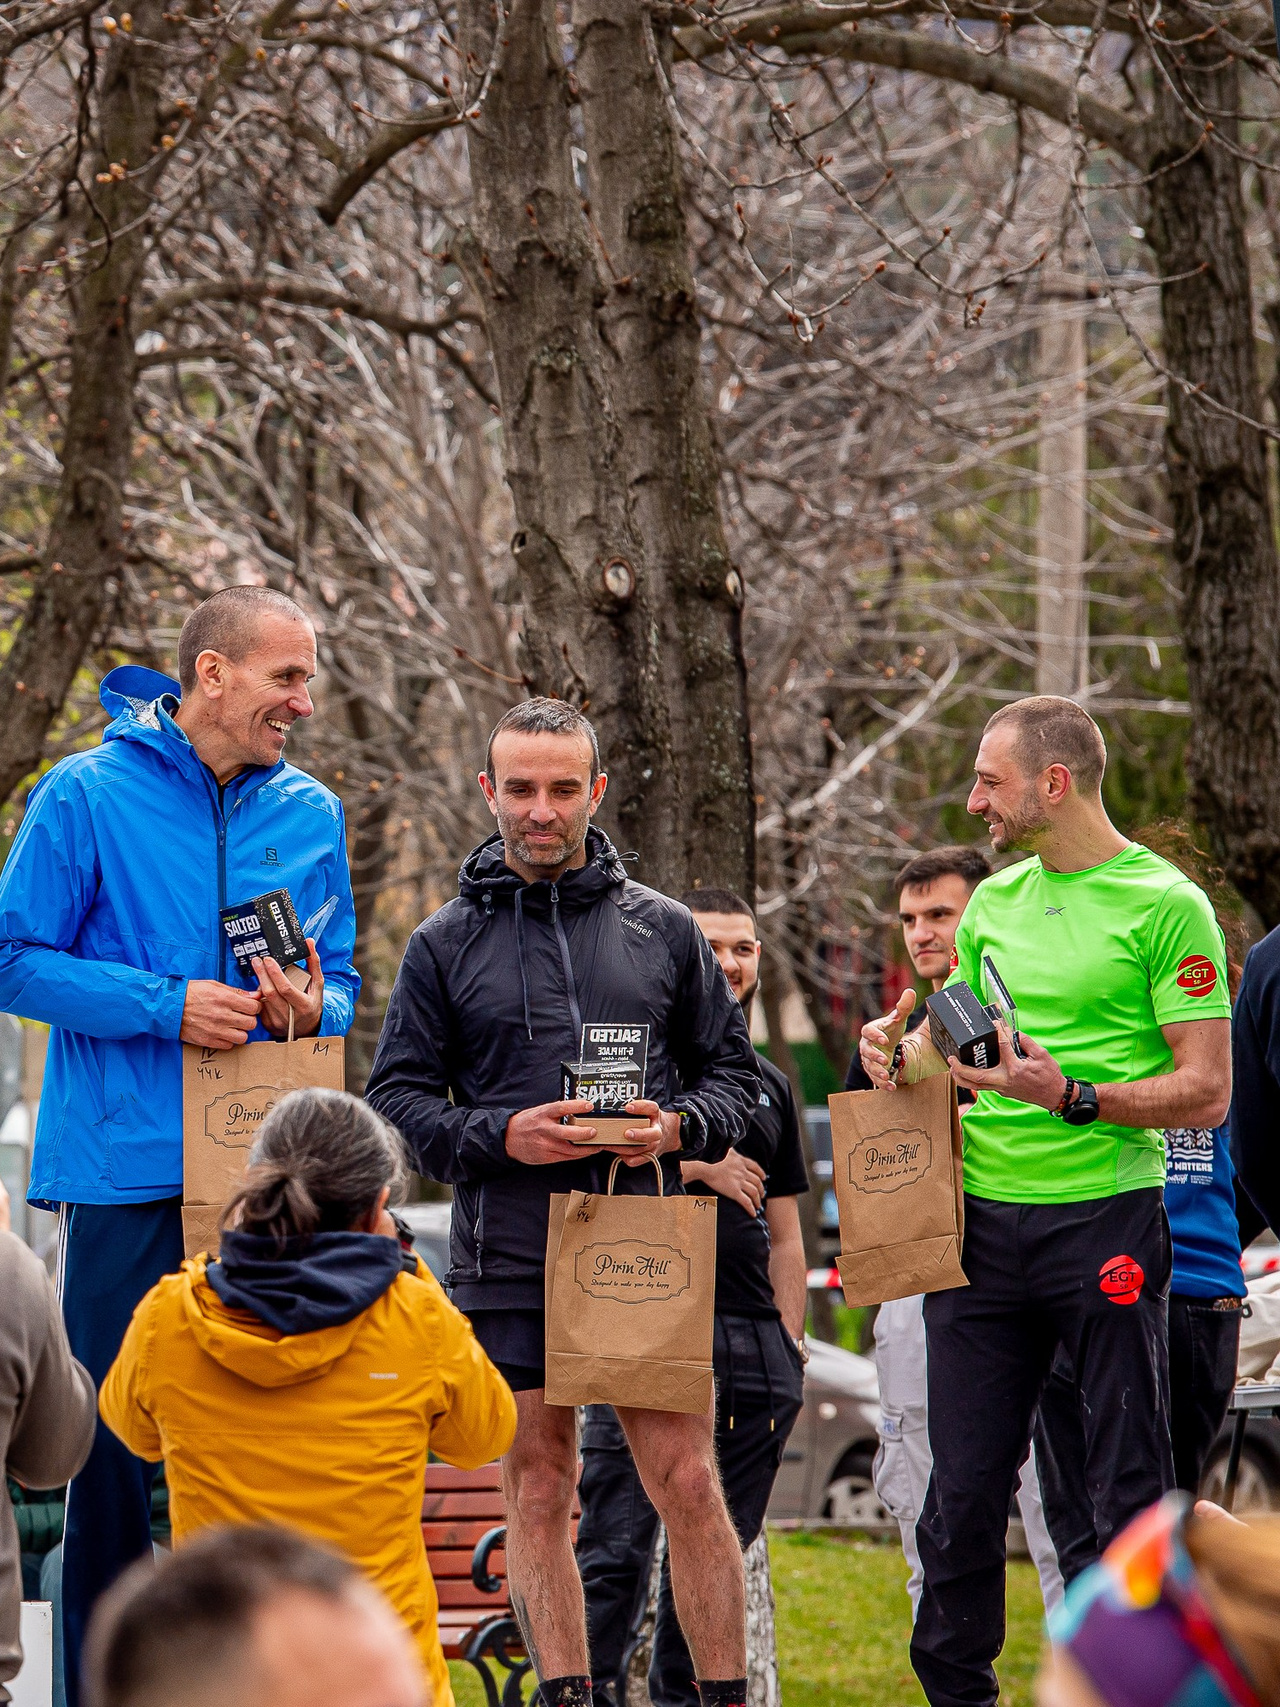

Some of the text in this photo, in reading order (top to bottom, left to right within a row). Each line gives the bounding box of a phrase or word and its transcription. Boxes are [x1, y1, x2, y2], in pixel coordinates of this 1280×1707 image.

[224, 914, 261, 938] SALTED
[269, 901, 289, 938] SALTED
[1184, 968, 1209, 979] EGT
[576, 1083, 639, 1101] SALTED
[225, 1103, 265, 1125] Pirin
[864, 1143, 920, 1171] Pirin Hill
[1174, 1161, 1213, 1172] MATTERS
[592, 1254, 669, 1278] Pirin Hill
[591, 1279, 612, 1287] Designed
[1109, 1271, 1136, 1282] EGT
